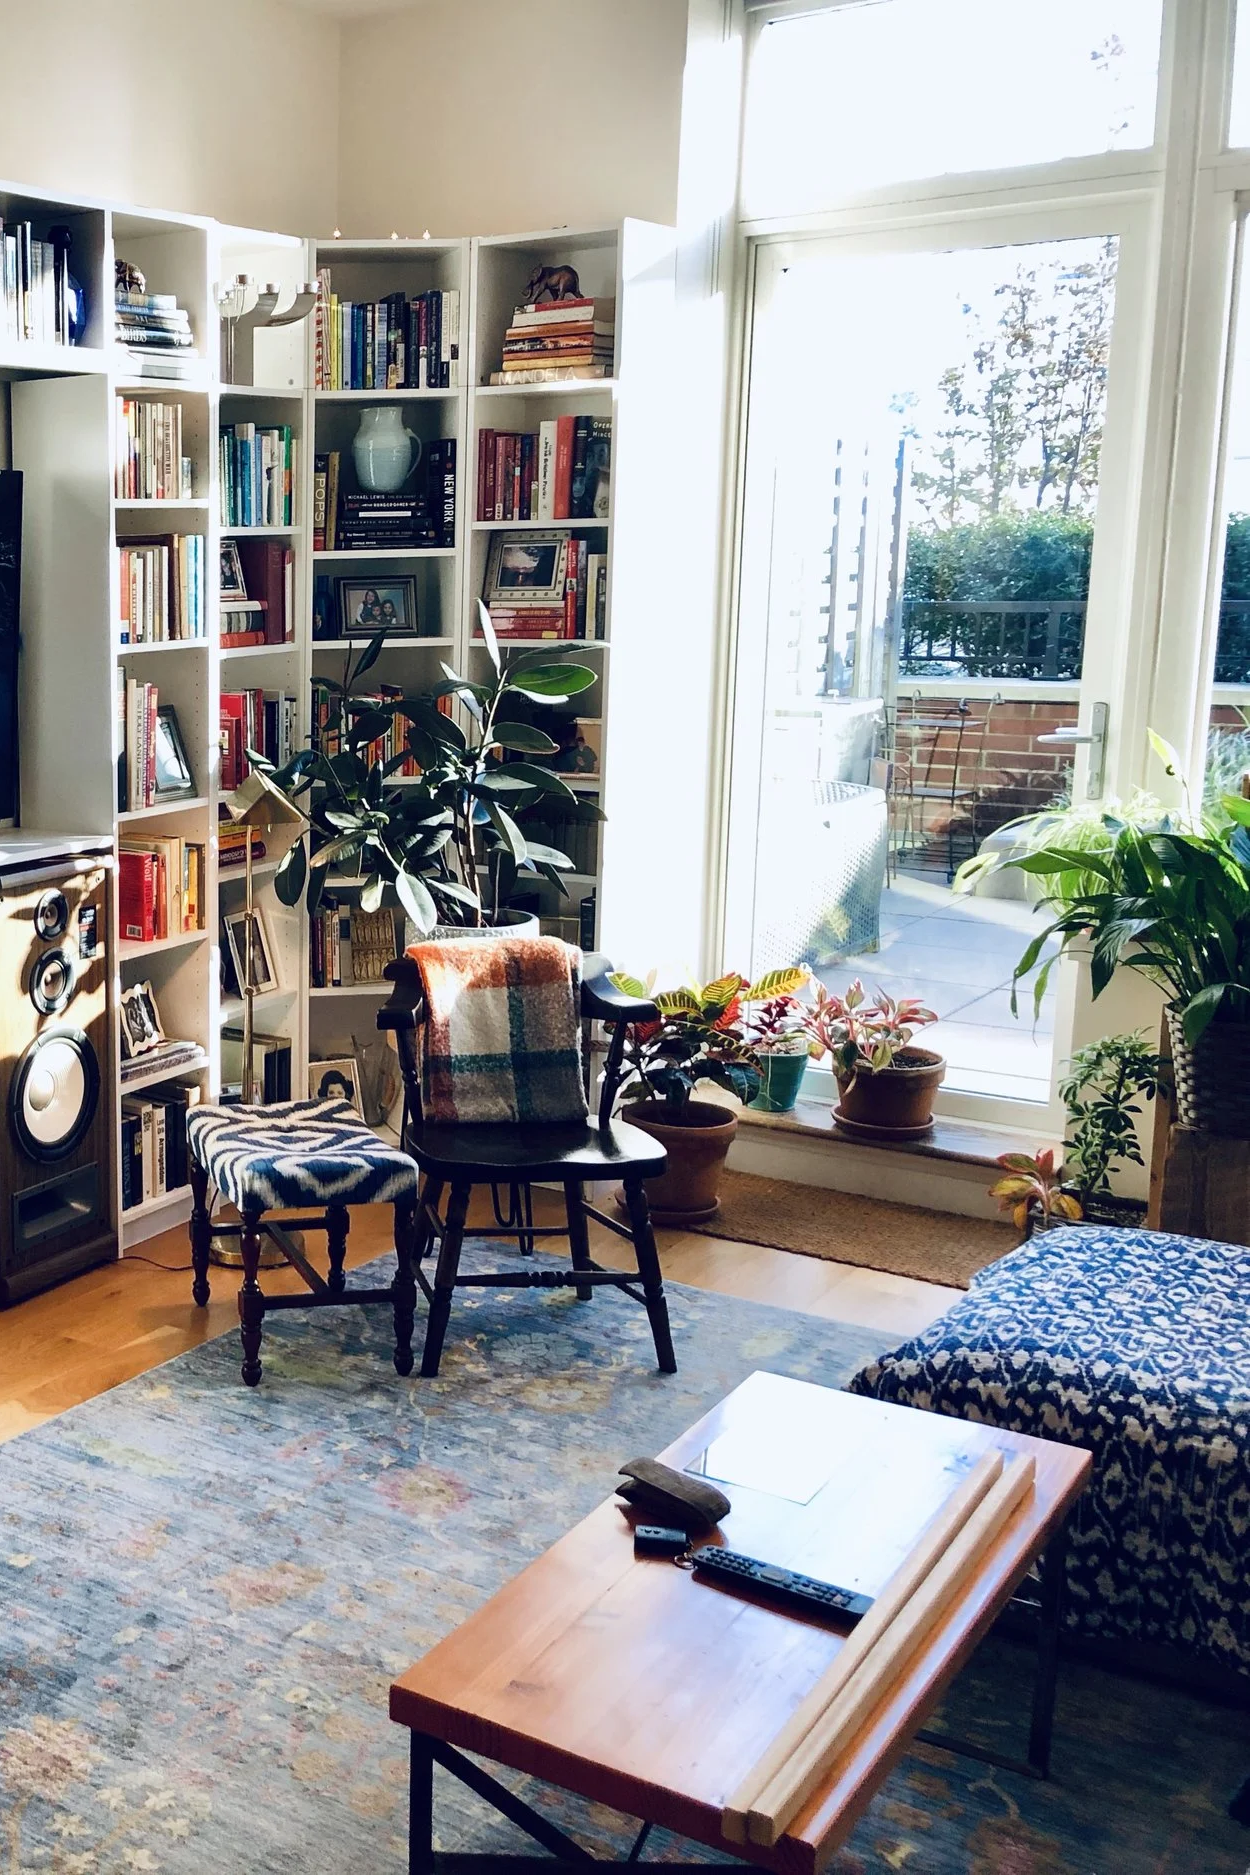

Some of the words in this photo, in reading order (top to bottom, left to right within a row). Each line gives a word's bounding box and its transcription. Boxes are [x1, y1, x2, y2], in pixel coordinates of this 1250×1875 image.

[498, 367, 576, 385] MANDELA
[444, 474, 454, 495] NEW
[315, 478, 325, 521] POPS
[444, 497, 454, 523] YORK
[144, 858, 152, 881] Wolf
